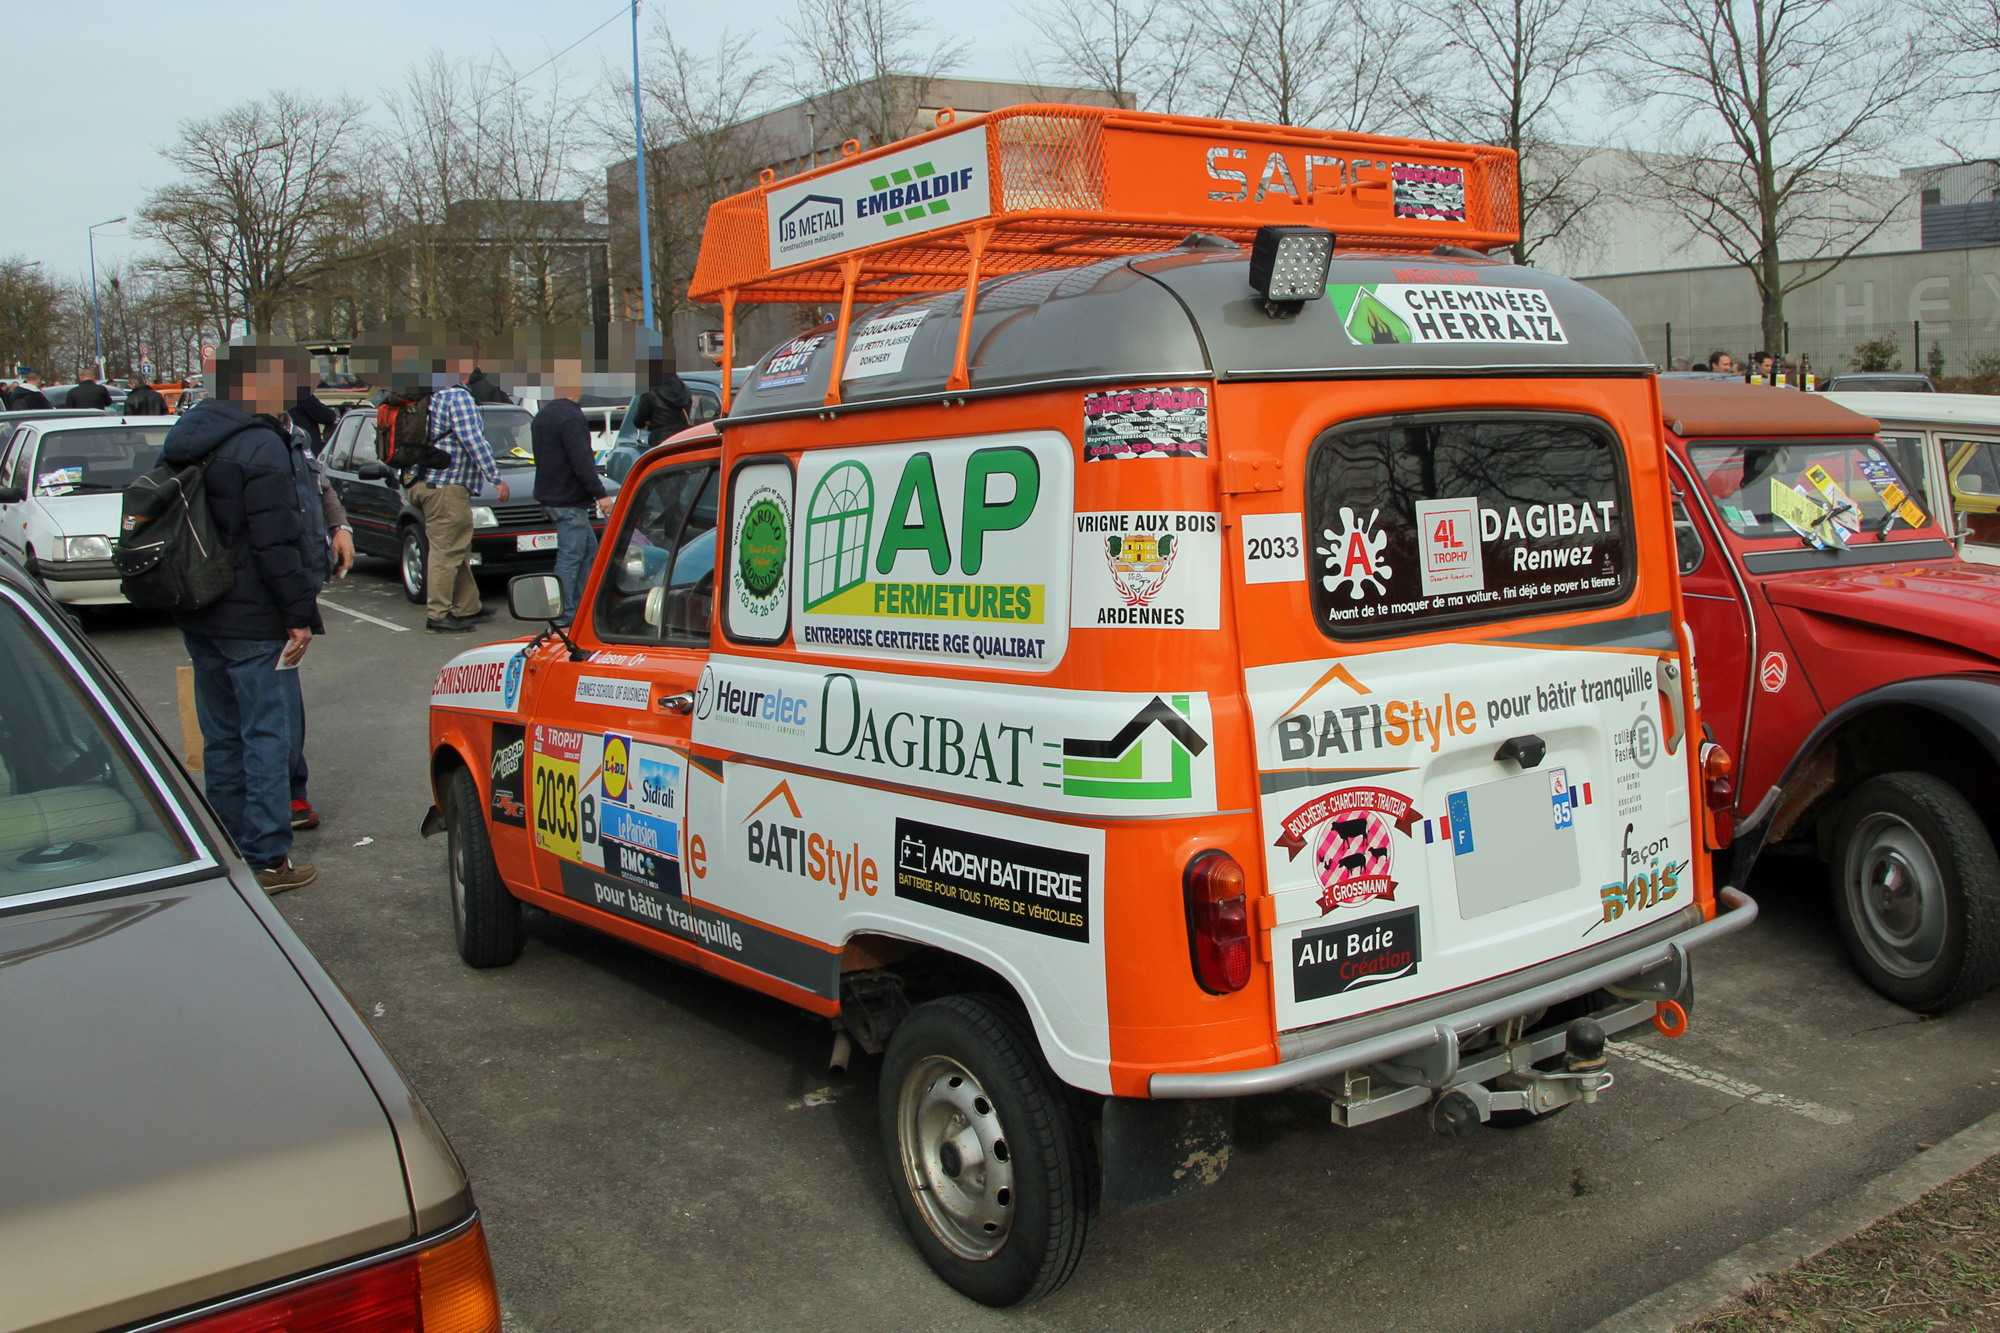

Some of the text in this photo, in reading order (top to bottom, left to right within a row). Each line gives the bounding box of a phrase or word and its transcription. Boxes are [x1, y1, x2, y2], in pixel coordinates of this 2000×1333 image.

[856, 167, 973, 219] EMBALDIF
[1206, 147, 1389, 211] SAPE
[784, 208, 839, 241] JB METAL
[780, 231, 845, 253] Constructions métalliques
[1392, 268, 1480, 284] MERCURY
[1405, 289, 1548, 313] CHEMINÉES
[860, 317, 922, 337] BOULANGERIE
[1413, 312, 1563, 342] HERRAIZ
[852, 334, 912, 353] AUX PETITS PLAISIRS
[859, 352, 892, 366] DONCHERY
[1086, 391, 1204, 416] GARAGE SP RACING
[1133, 415, 1158, 423] toutes
[1160, 415, 1194, 423] marques
[1087, 433, 1150, 443] Reprogrammation
[1090, 443, 1202, 456] 03 24 59 34 66
[746, 509, 782, 540] CAROLO
[875, 445, 1041, 577] AP
[1077, 515, 1216, 533] VRIGNE AUX BOIS
[1480, 500, 1614, 542] DAGIBAT
[1434, 519, 1464, 548] 4L
[1247, 536, 1299, 560] 2033
[1343, 532, 1374, 577] A
[1434, 551, 1468, 564] TROPHY
[1513, 546, 1594, 572] Renwez
[745, 558, 779, 588] BOISSONS
[734, 570, 787, 617] Tél. 03 24 26 62 57
[874, 583, 1032, 620] FERMETURES
[1329, 605, 1359, 621] Avant
[1361, 604, 1375, 617] de
[1377, 603, 1389, 615] te
[1391, 599, 1429, 616] moquer
[1433, 596, 1445, 608] de
[1448, 595, 1464, 606] ma
[1466, 589, 1501, 605] voiture,
[1503, 587, 1517, 599] fini
[1519, 583, 1538, 599] déjà
[1540, 583, 1552, 595] de
[1553, 580, 1579, 596] payer
[1580, 578, 1590, 589] la
[1591, 576, 1615, 589] tienne
[1097, 607, 1185, 625] ARDENNES
[804, 625, 1046, 660] ENTREPRISE CERTIFIEE RGE QUALIBAT
[597, 650, 628, 666] Jason
[578, 682, 649, 703] RENNES SCHOOL OF BUSINESS
[717, 680, 808, 725] Heurelec
[715, 714, 806, 737] HORLOGERIE INDUSTRIEL CAMPANISTE
[1277, 666, 1653, 762] BATIStyle pour bâtir tranquille
[534, 724, 582, 749] 4L TROPHY
[815, 673, 1034, 788] DAGIBAT
[1614, 728, 1637, 746] collège
[503, 740, 524, 761] ROAD
[1615, 746, 1638, 763] Pasteur
[1617, 771, 1640, 784] académie
[1626, 781, 1641, 791] Reims
[536, 765, 578, 843] 2033
[642, 779, 675, 809] Sidi ali
[1288, 791, 1407, 838] BOUCHERIE CHARCUTERIE TRAITEUR
[1553, 801, 1571, 824] 85
[1619, 804, 1642, 817] nationale
[617, 816, 626, 838] Le
[626, 813, 658, 849] Parisien
[1459, 830, 1466, 845] F
[620, 847, 645, 875] RMC
[748, 819, 879, 901] BATIStyle
[1621, 822, 1669, 895] façon
[898, 872, 1084, 927] BATTERIE POUR TOUS TYPES DE VÉHICULES
[1333, 879, 1389, 900] GROSSMANN
[1600, 857, 1679, 924] BOIS
[594, 881, 743, 951] pour bâtir tranquille
[1298, 927, 1394, 967] Alu Baie
[1340, 950, 1411, 980] Création
